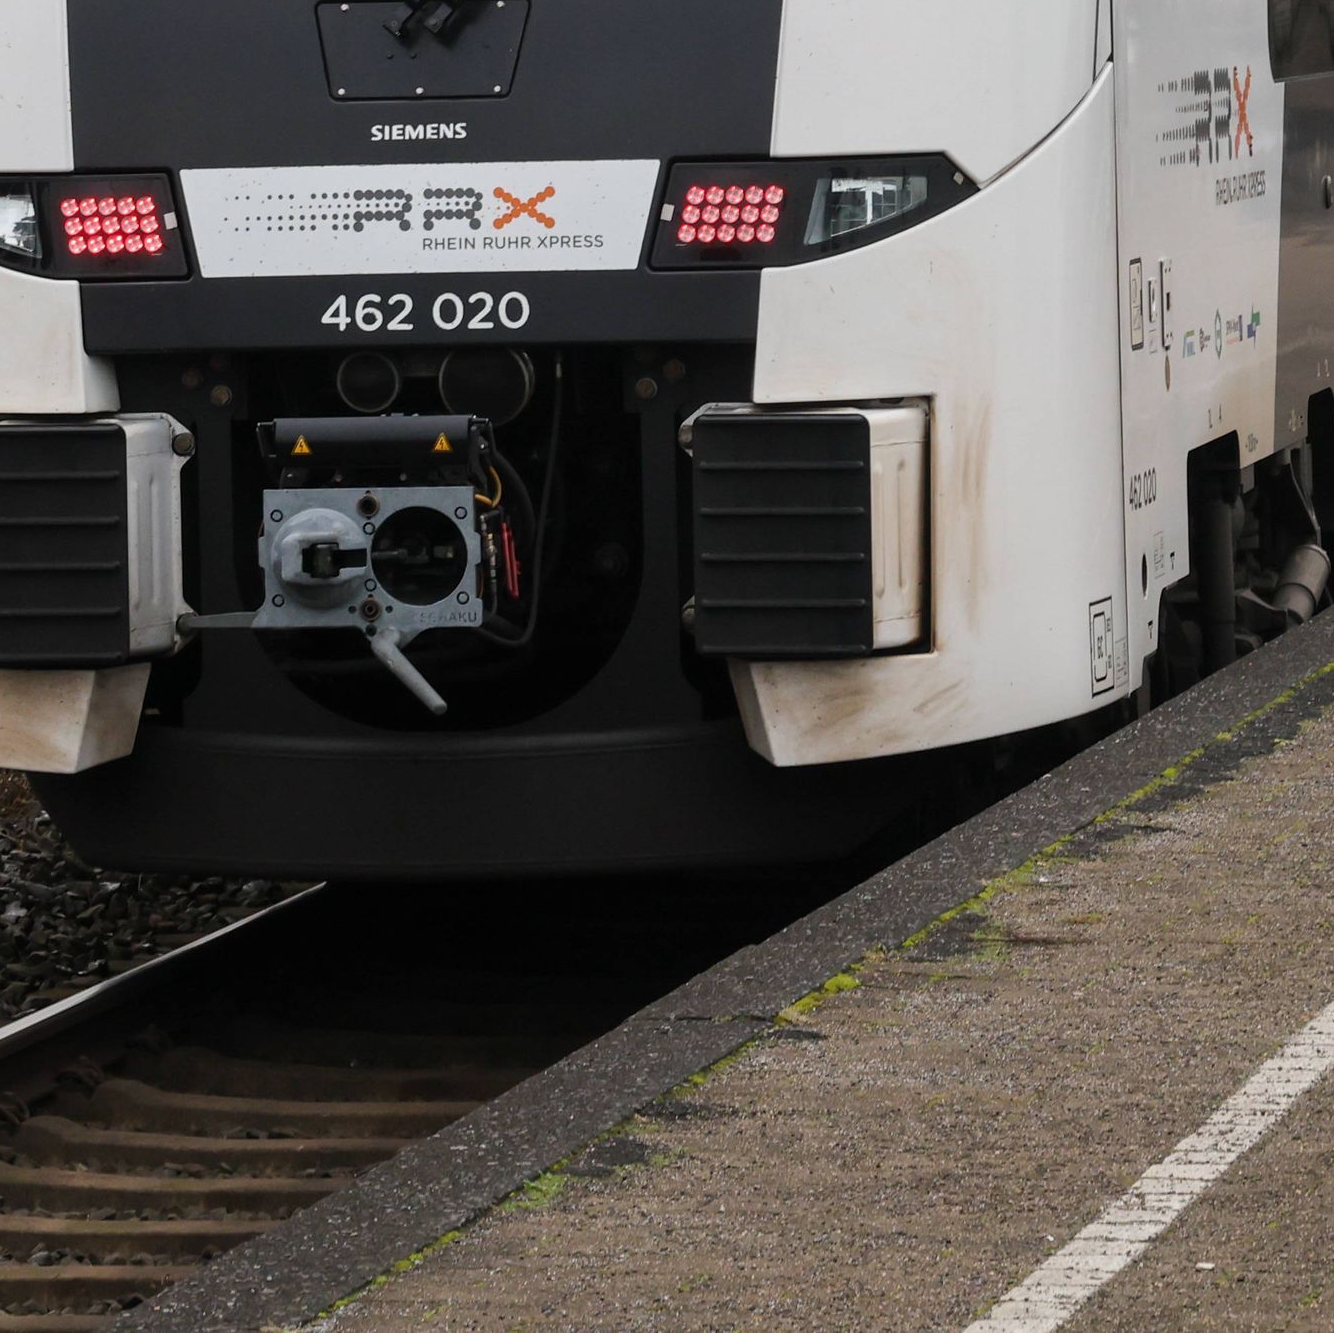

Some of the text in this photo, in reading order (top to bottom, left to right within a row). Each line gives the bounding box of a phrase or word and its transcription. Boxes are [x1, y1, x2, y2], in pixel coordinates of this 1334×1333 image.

[370, 122, 468, 142] SIEMENS
[422, 234, 605, 251] RHEIN RUHR XPRESS
[320, 289, 531, 333] 462 020
[1129, 466, 1157, 511] 462 020
